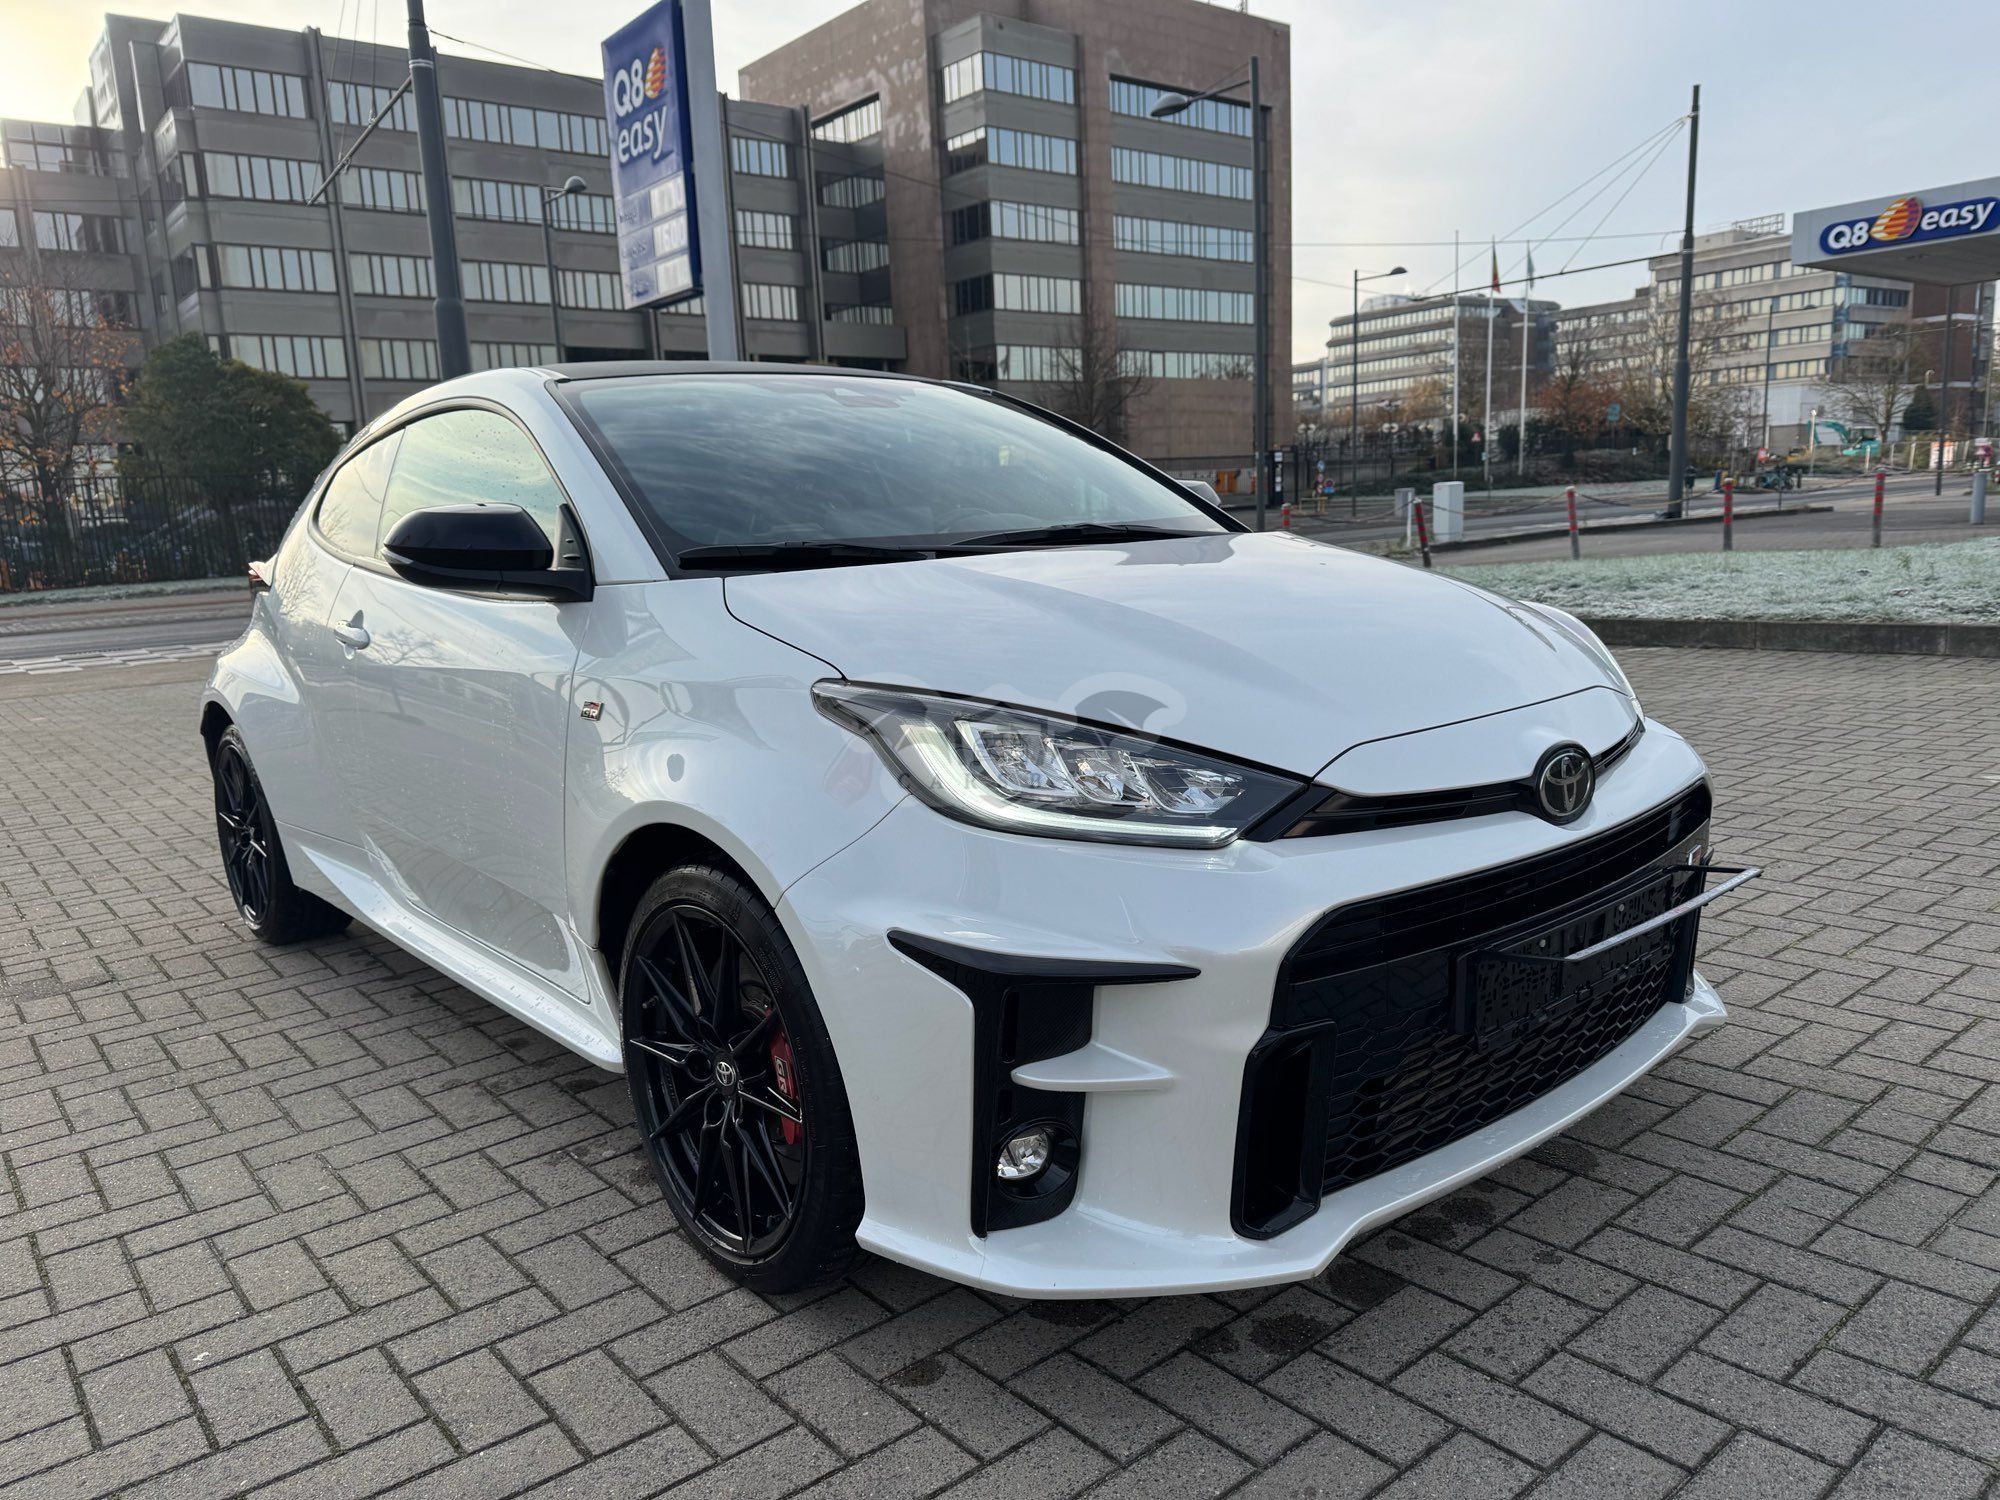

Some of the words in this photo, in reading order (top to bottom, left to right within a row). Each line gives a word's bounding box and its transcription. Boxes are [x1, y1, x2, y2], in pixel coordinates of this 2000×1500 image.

[613, 58, 644, 117] Q8
[618, 105, 667, 163] easy
[1827, 222, 1869, 250] Q8
[1920, 201, 1996, 231] easy
